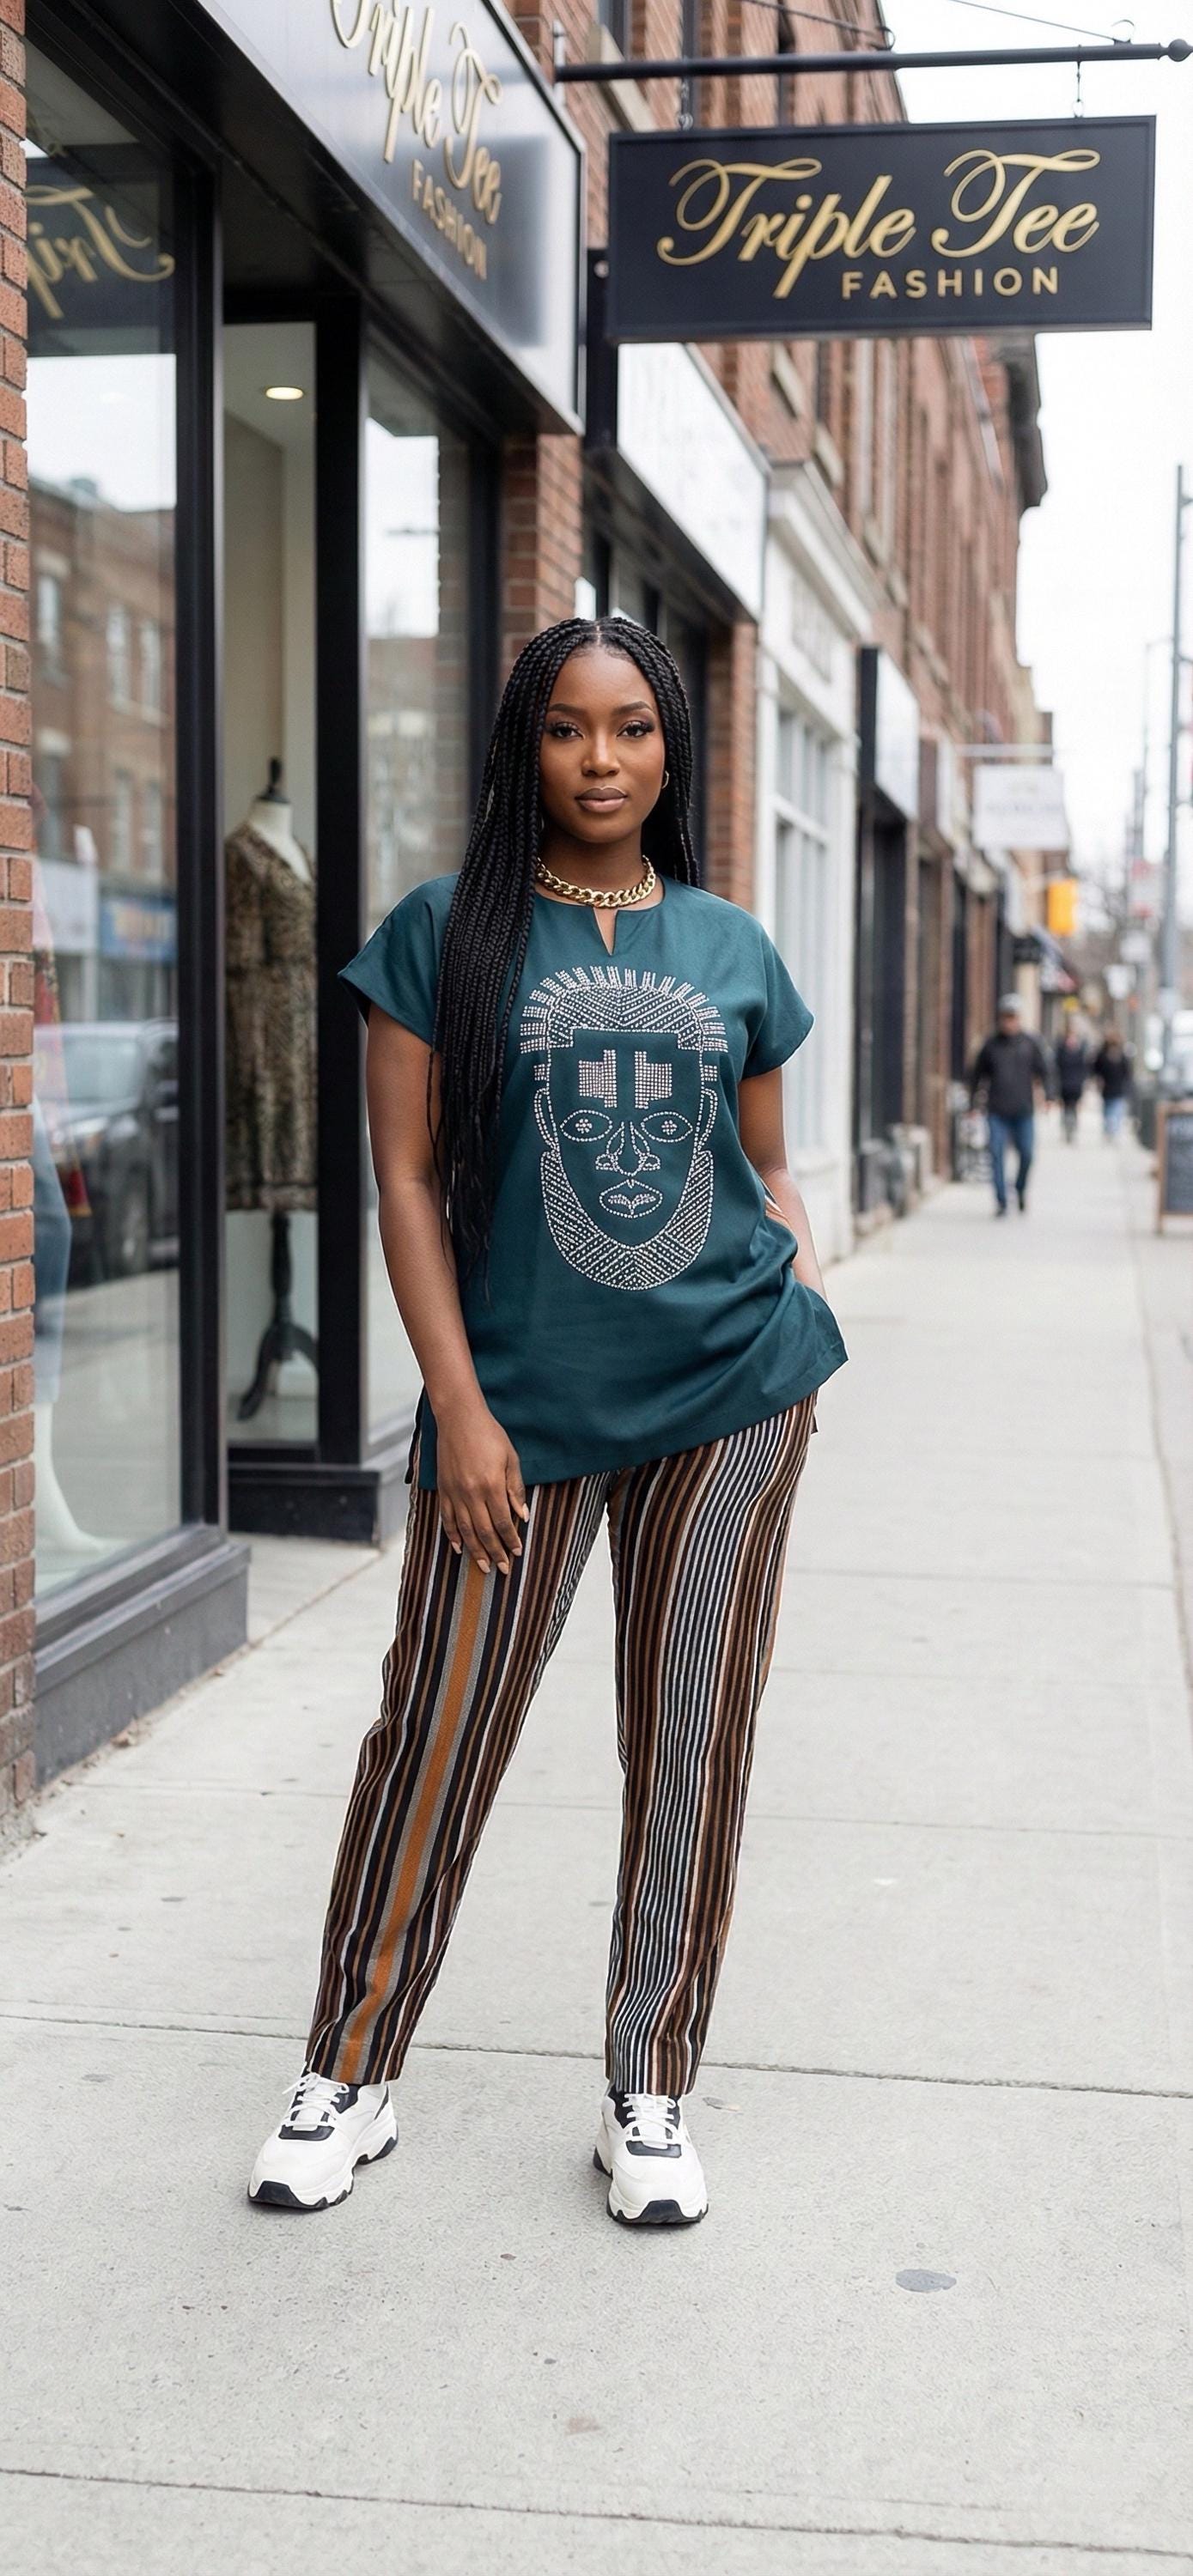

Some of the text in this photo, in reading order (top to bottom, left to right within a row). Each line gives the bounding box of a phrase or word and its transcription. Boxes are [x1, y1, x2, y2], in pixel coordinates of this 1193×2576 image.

[444, 21, 501, 225] Tee
[411, 159, 487, 281] FASHION
[657, 149, 1100, 300] Triple Tee
[842, 266, 1059, 300] FASHION
